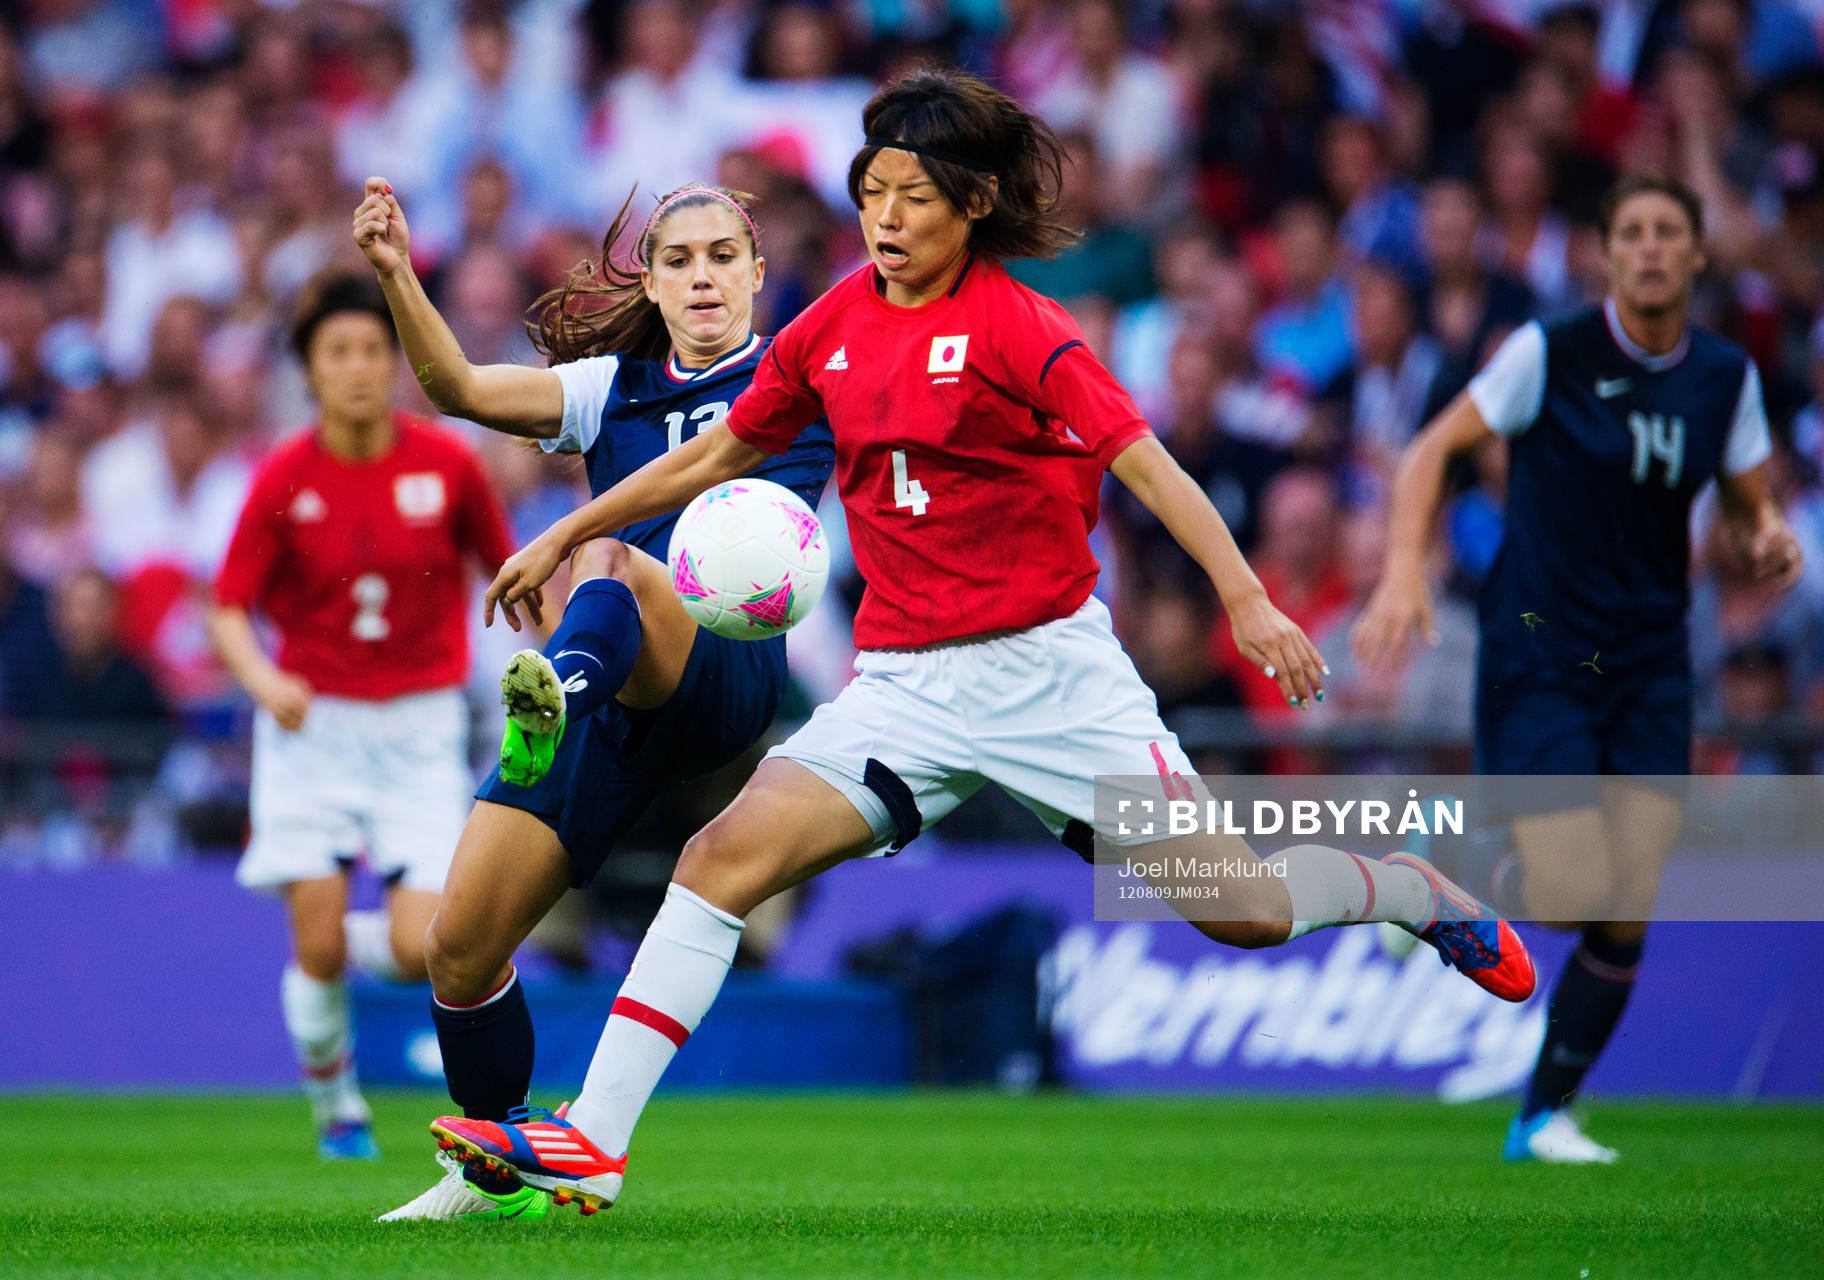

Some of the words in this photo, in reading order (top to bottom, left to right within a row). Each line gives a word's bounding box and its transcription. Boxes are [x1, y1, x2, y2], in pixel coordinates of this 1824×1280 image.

[892, 448, 930, 516] 4
[1627, 409, 1687, 489] 14
[350, 573, 391, 640] 2
[1149, 741, 1197, 802] 4
